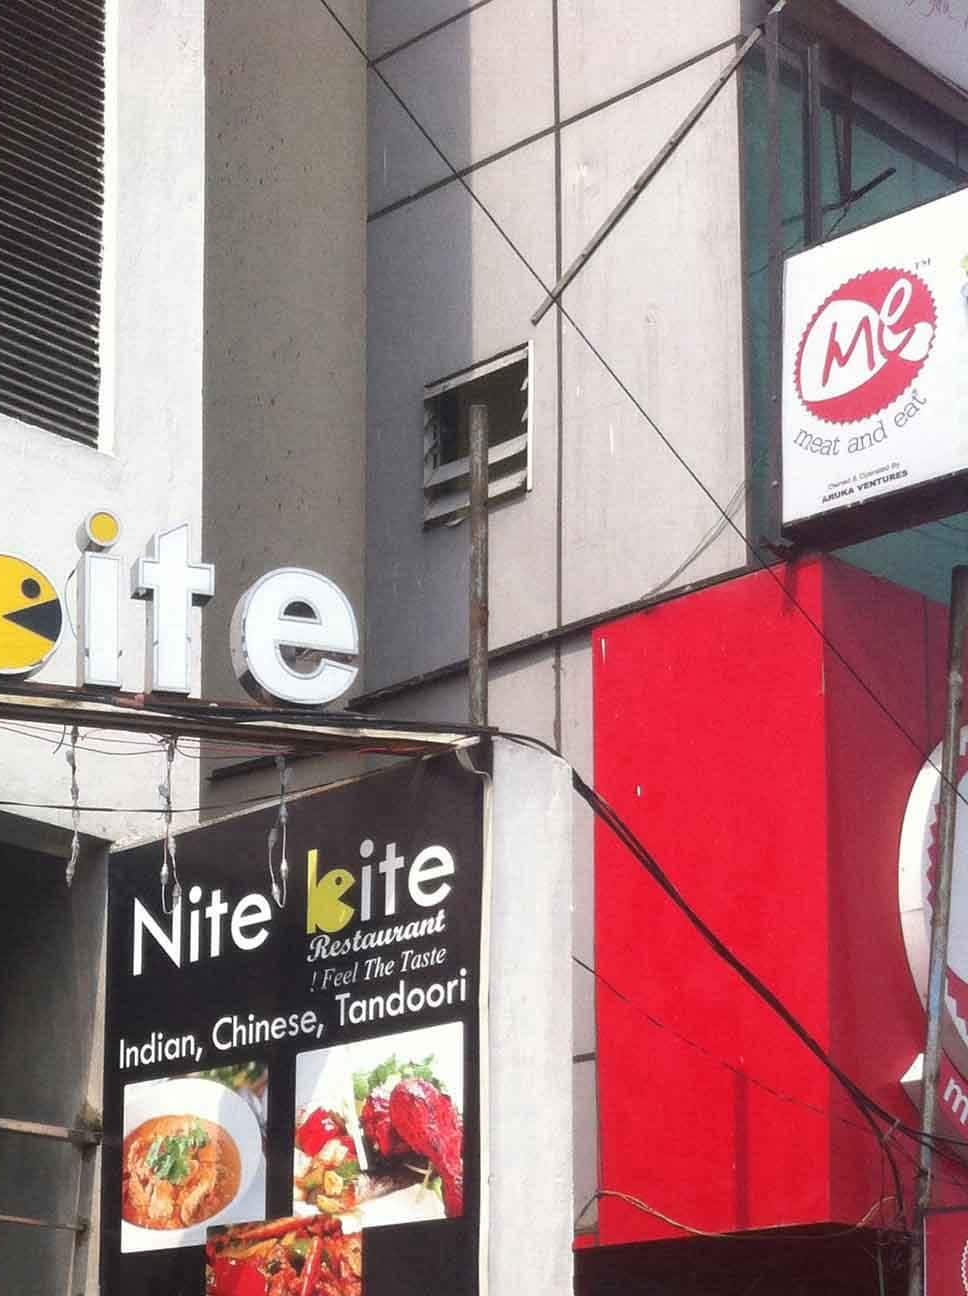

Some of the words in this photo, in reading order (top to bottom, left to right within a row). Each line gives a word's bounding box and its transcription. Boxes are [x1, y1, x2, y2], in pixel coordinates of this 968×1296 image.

[793, 428, 841, 456] meat
[847, 419, 889, 454] and
[894, 387, 928, 428] eat
[856, 469, 909, 491] VENTURES
[132, 884, 273, 977] Nite
[306, 908, 446, 963] Restaurant
[321, 961, 359, 992] Feel
[363, 955, 396, 981] The
[400, 946, 447, 973] Taste
[119, 1031, 203, 1070] Indian,
[212, 1009, 324, 1052] Chinese,
[335, 967, 467, 1026] Tandoori
